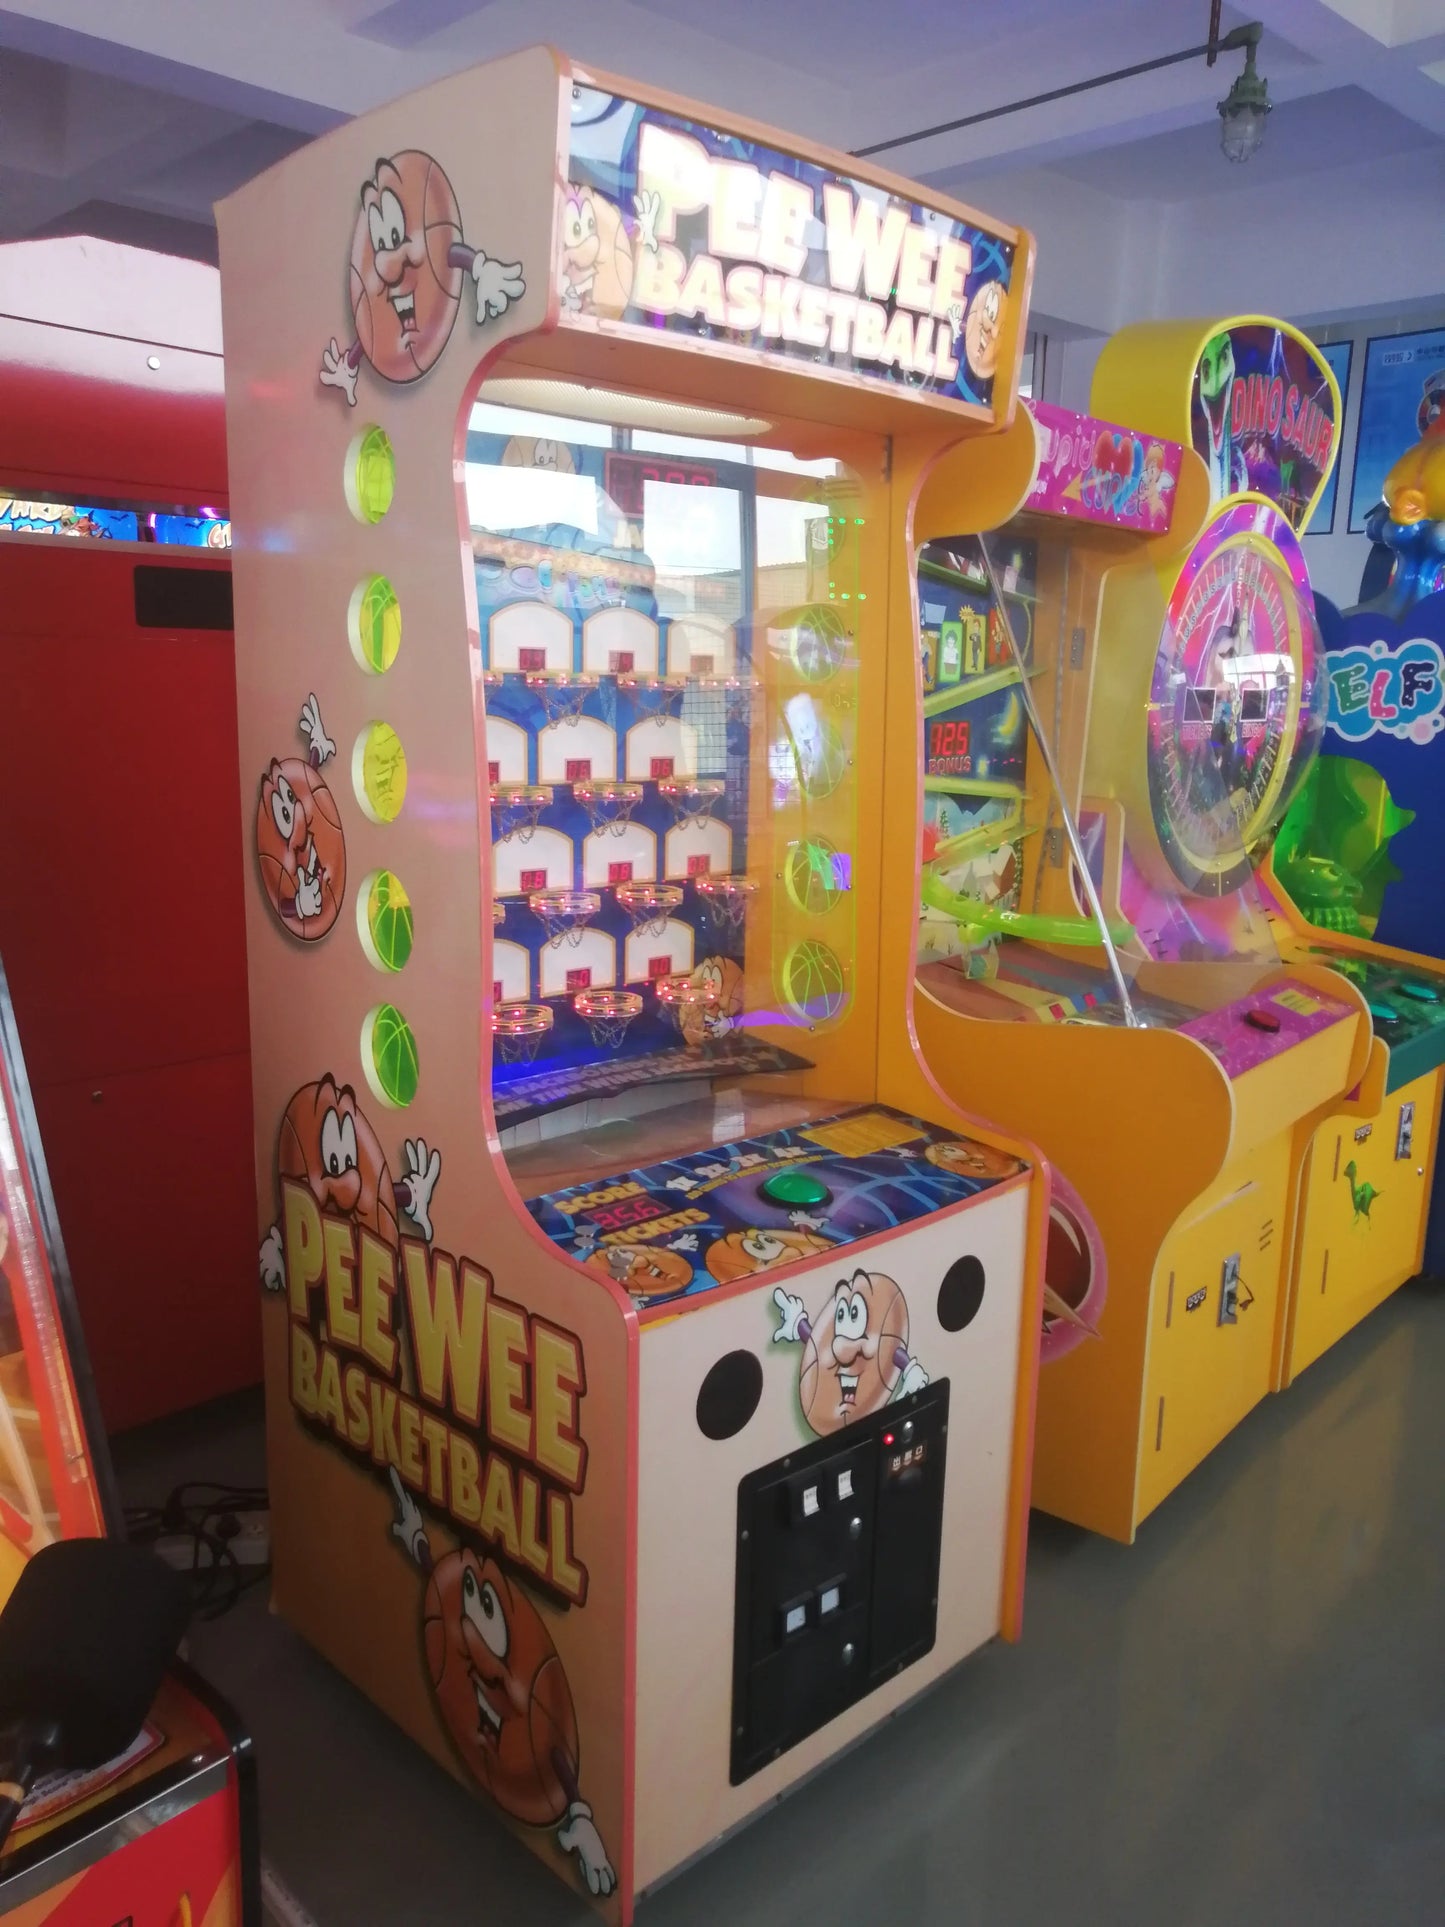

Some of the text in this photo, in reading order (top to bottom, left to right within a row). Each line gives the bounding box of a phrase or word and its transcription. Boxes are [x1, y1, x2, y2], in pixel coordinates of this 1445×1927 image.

[636, 122, 973, 318] PEE WEE
[632, 242, 959, 381] BASKETBALL
[1332, 660, 1437, 720] ELF
[928, 755, 971, 775] BONUS
[931, 721, 970, 756] 125
[553, 1181, 648, 1215] SCORE
[599, 1207, 711, 1246] TICKETS
[281, 1178, 587, 1493] PEE WEE
[290, 1325, 588, 1603] BASKETBALL
